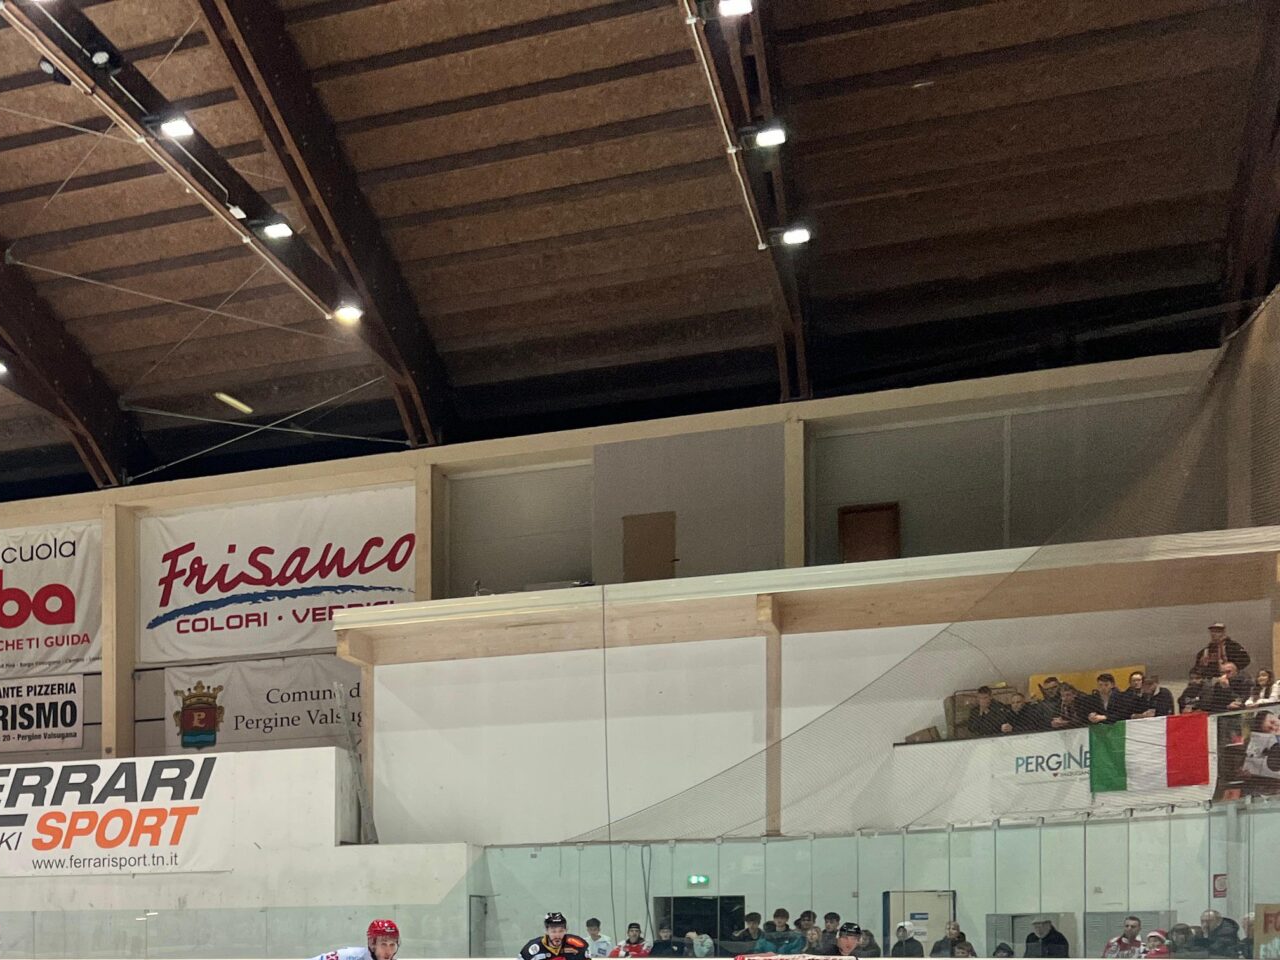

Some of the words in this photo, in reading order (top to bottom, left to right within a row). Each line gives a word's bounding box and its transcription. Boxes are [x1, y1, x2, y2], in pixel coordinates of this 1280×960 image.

[158, 533, 416, 608] Frisanco
[176, 612, 268, 634] COLORI
[27, 637, 40, 649] TI
[44, 633, 91, 647] GUIDA
[26, 682, 77, 698] PIZZERIA
[233, 713, 301, 734] Pergine
[17, 733, 42, 743] Pergine
[43, 731, 78, 742] Valsugana
[31, 806, 200, 851] SPORT
[32, 853, 179, 871] www.ferrarisport.tn.it
